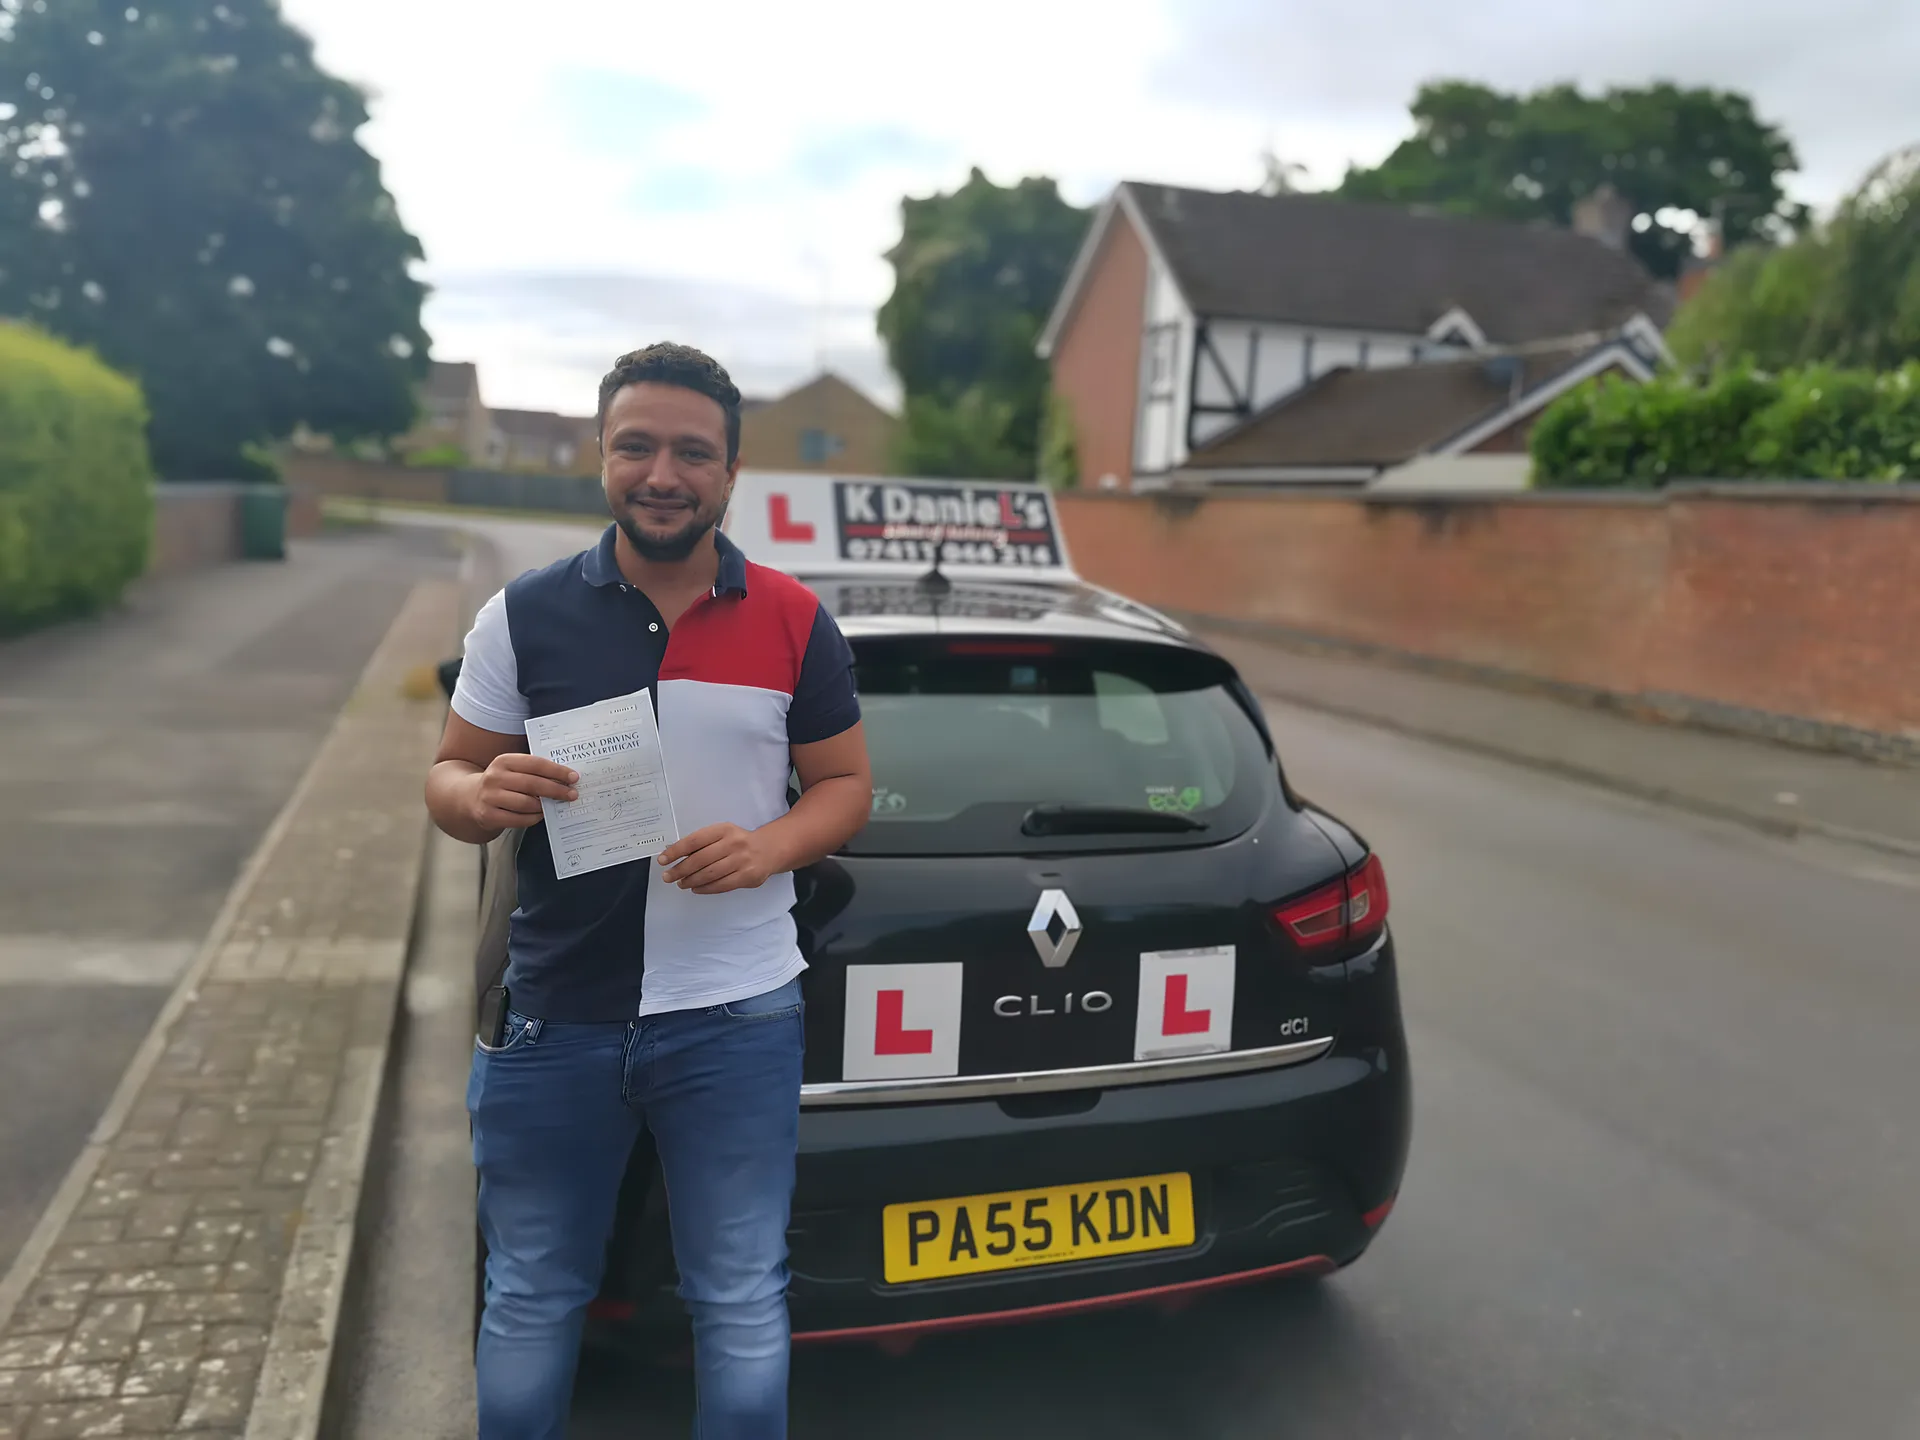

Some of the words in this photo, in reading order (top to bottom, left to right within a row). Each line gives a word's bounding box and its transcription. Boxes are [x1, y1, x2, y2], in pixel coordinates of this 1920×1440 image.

[768, 493, 816, 543] L
[844, 486, 878, 521] K
[550, 740, 597, 758] PRACTICAL
[600, 732, 640, 746] DRIVING
[572, 748, 591, 760] PASS
[592, 740, 641, 756] CERTIFICATE
[874, 990, 933, 1055] L
[993, 990, 1113, 1016] CLIO
[1162, 974, 1211, 1036] L
[1070, 1183, 1170, 1247] KDN
